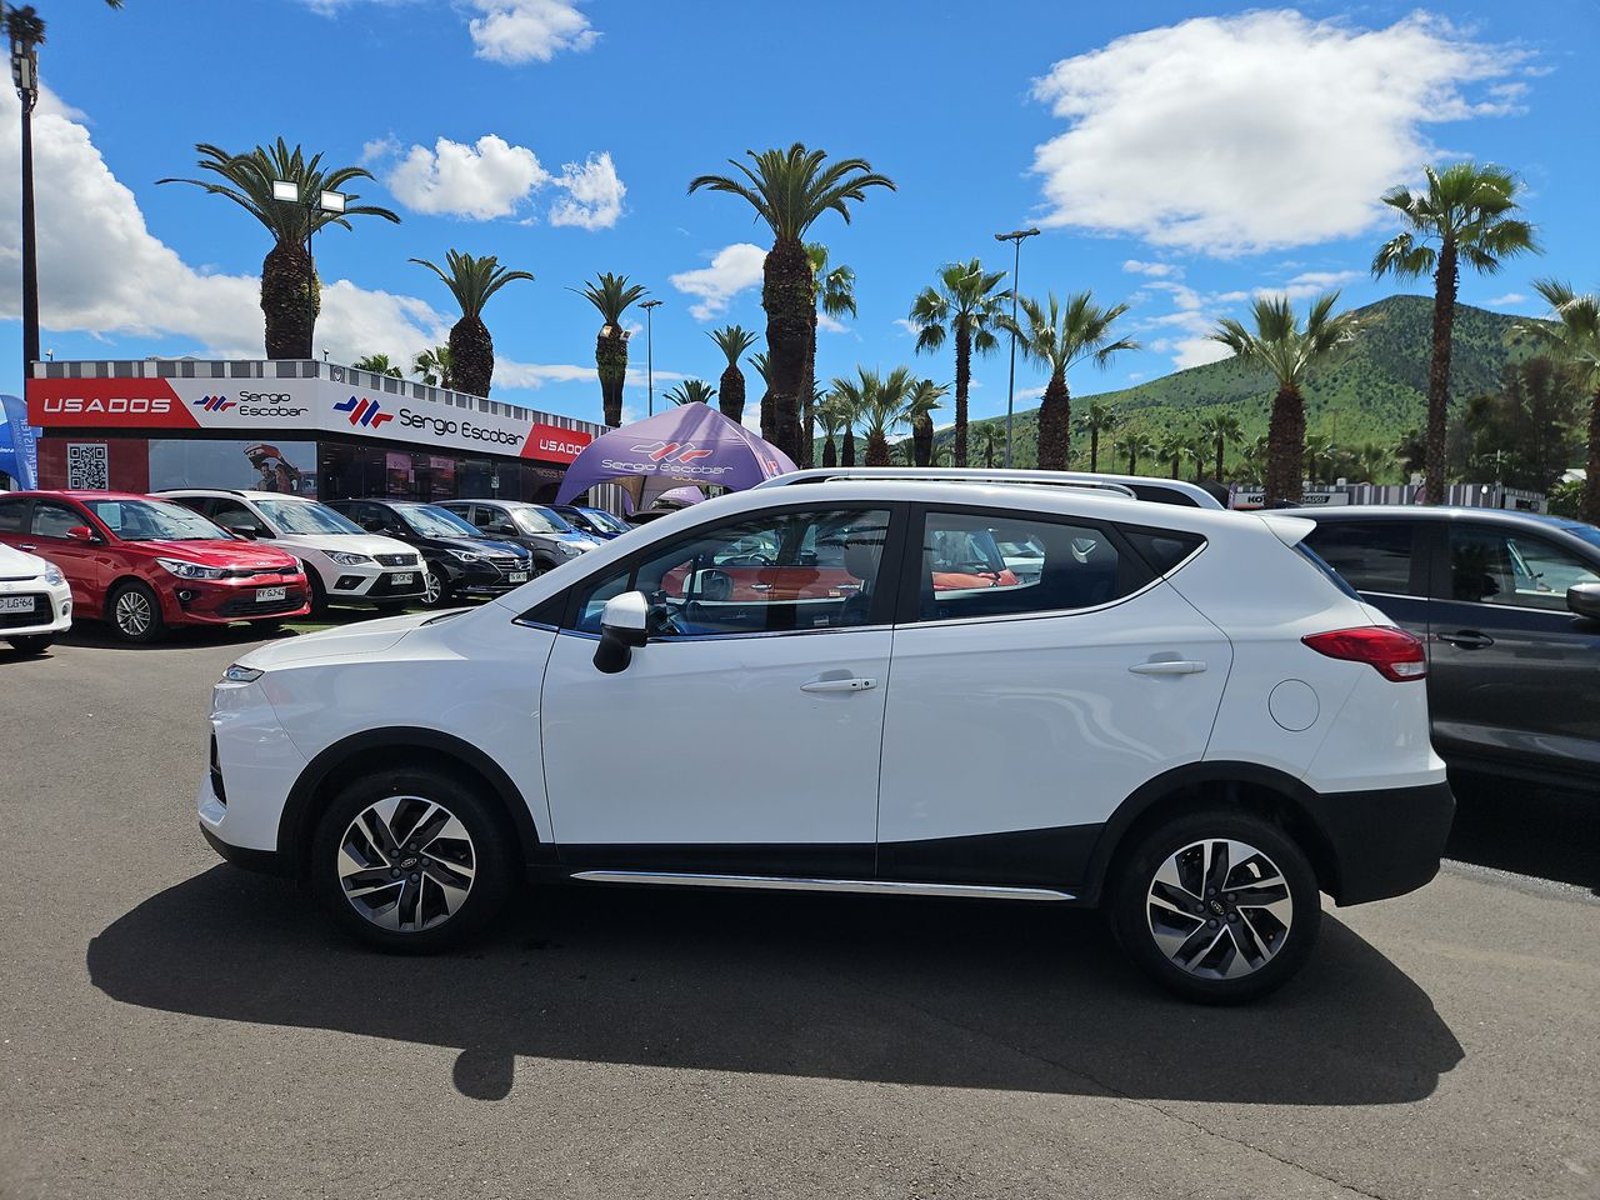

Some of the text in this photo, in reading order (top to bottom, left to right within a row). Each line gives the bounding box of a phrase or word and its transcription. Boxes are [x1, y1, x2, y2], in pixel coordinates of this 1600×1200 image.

[239, 390, 291, 405] Sergio
[43, 398, 171, 413] USADOS
[239, 405, 309, 417] Escobar
[399, 408, 525, 446] Sergio Escobar
[539, 439, 586, 455] USADO
[601, 459, 734, 475] Sergio Escobar
